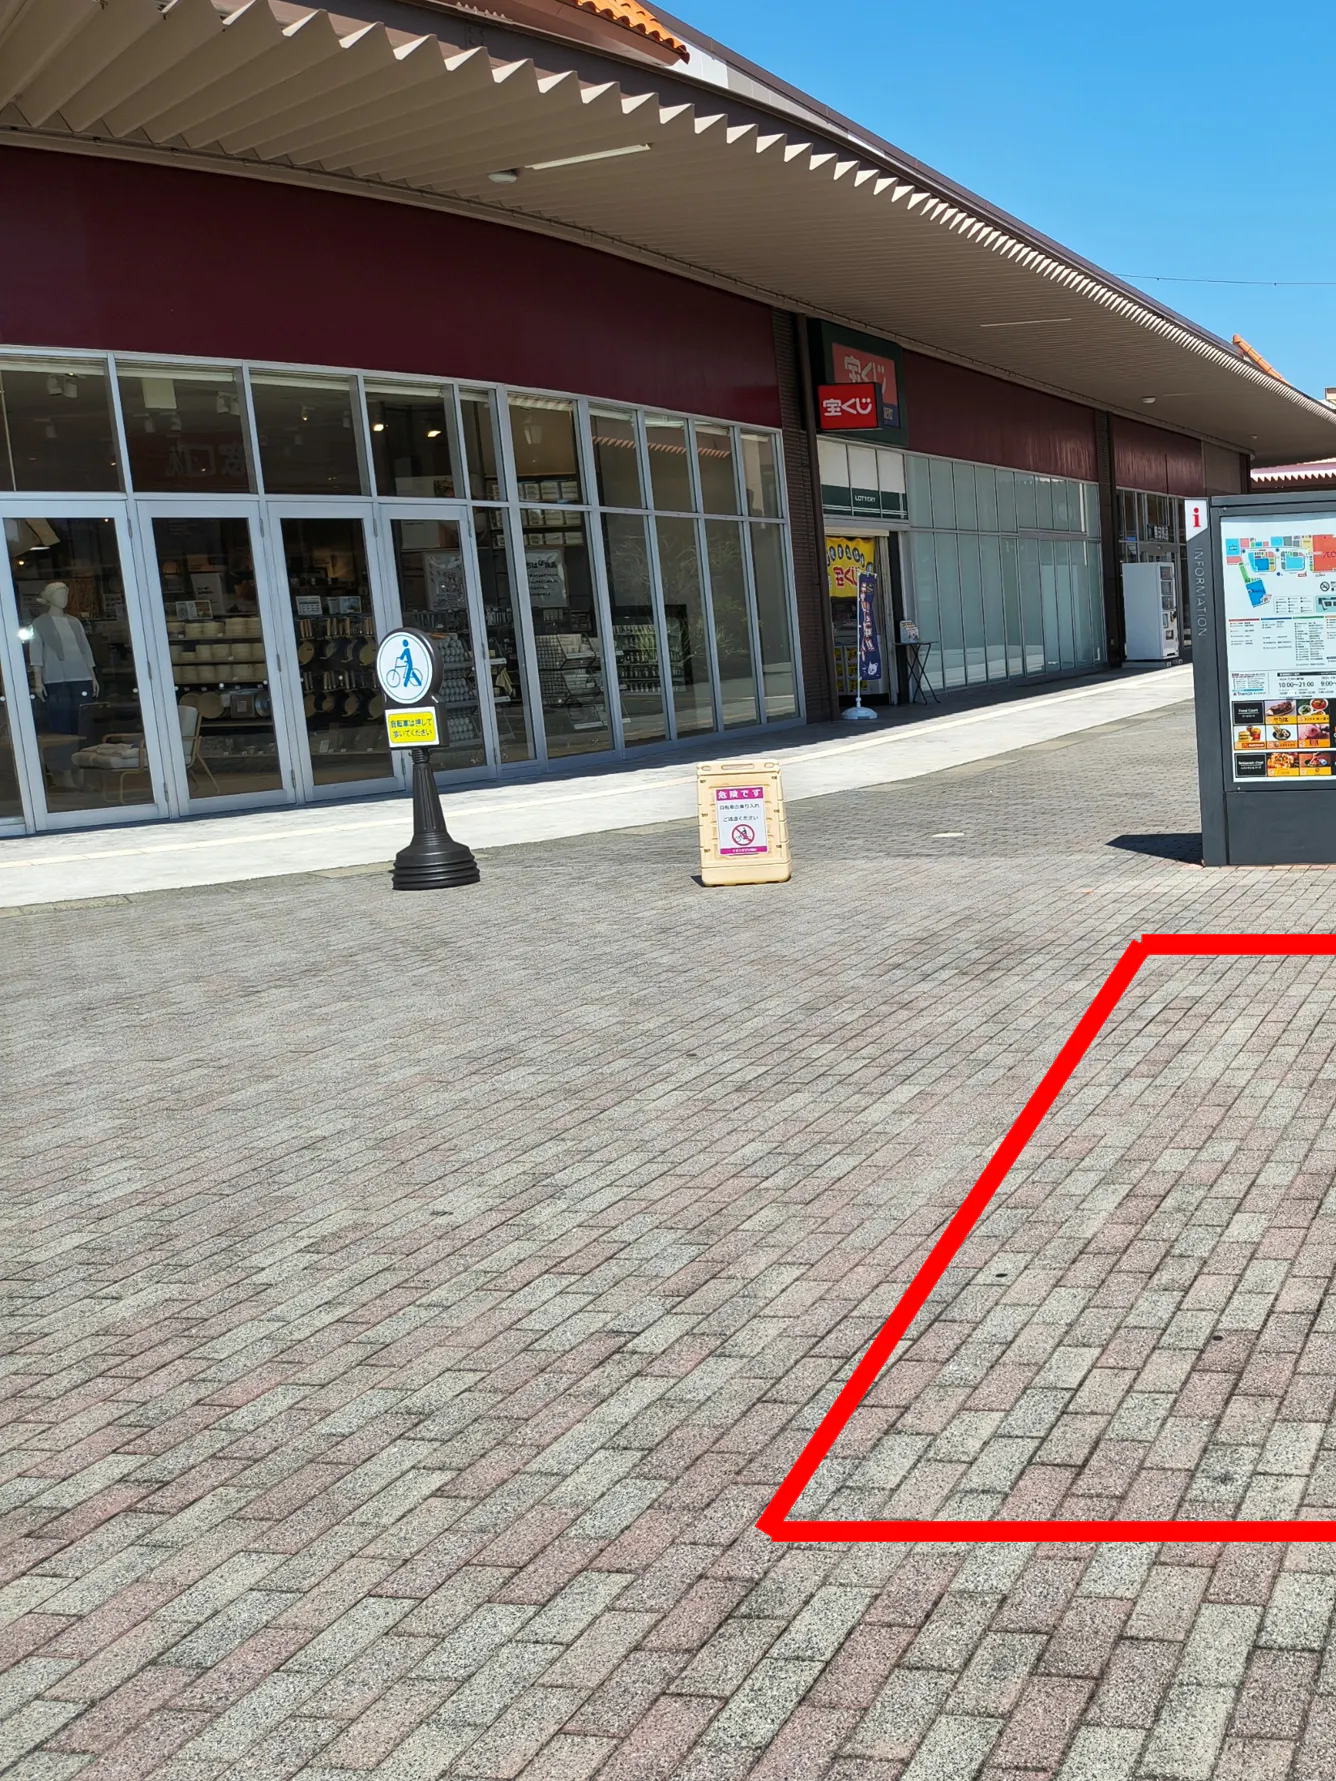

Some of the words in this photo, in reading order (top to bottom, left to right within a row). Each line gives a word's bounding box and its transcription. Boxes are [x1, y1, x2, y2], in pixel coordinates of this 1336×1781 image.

[823, 398, 872, 416] 宝くじ
[1193, 547, 1208, 637] INFORMATION
[391, 718, 432, 728] 自転車は押して
[718, 788, 761, 799] 危険です
